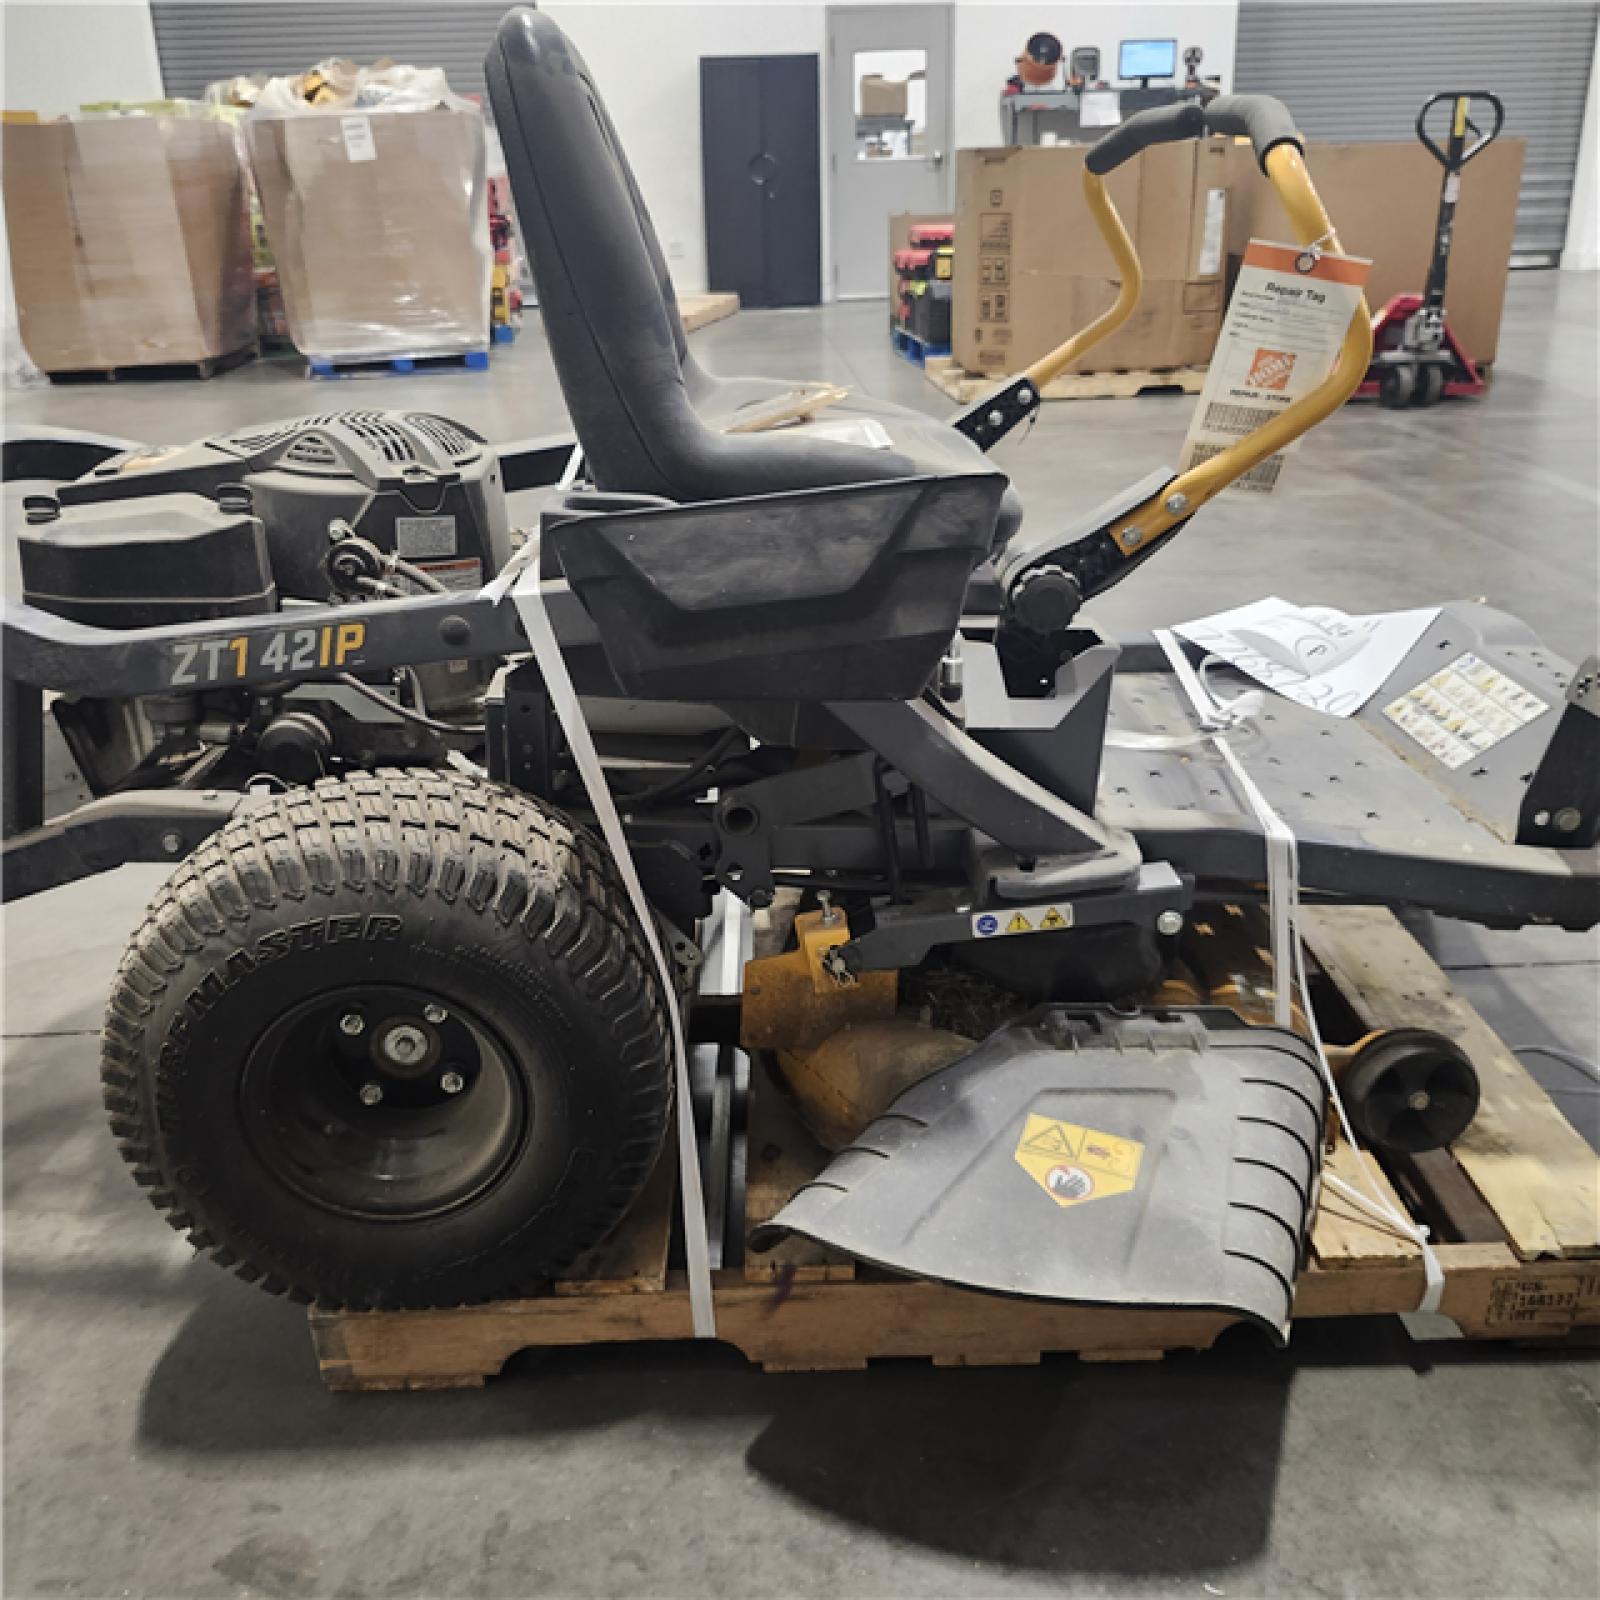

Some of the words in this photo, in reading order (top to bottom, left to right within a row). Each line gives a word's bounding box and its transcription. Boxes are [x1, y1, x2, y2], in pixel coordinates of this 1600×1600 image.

[1265, 281, 1304, 299] Repair
[1307, 288, 1326, 304] Tag
[170, 636, 249, 686] ZT1
[259, 623, 366, 674] 42IP
